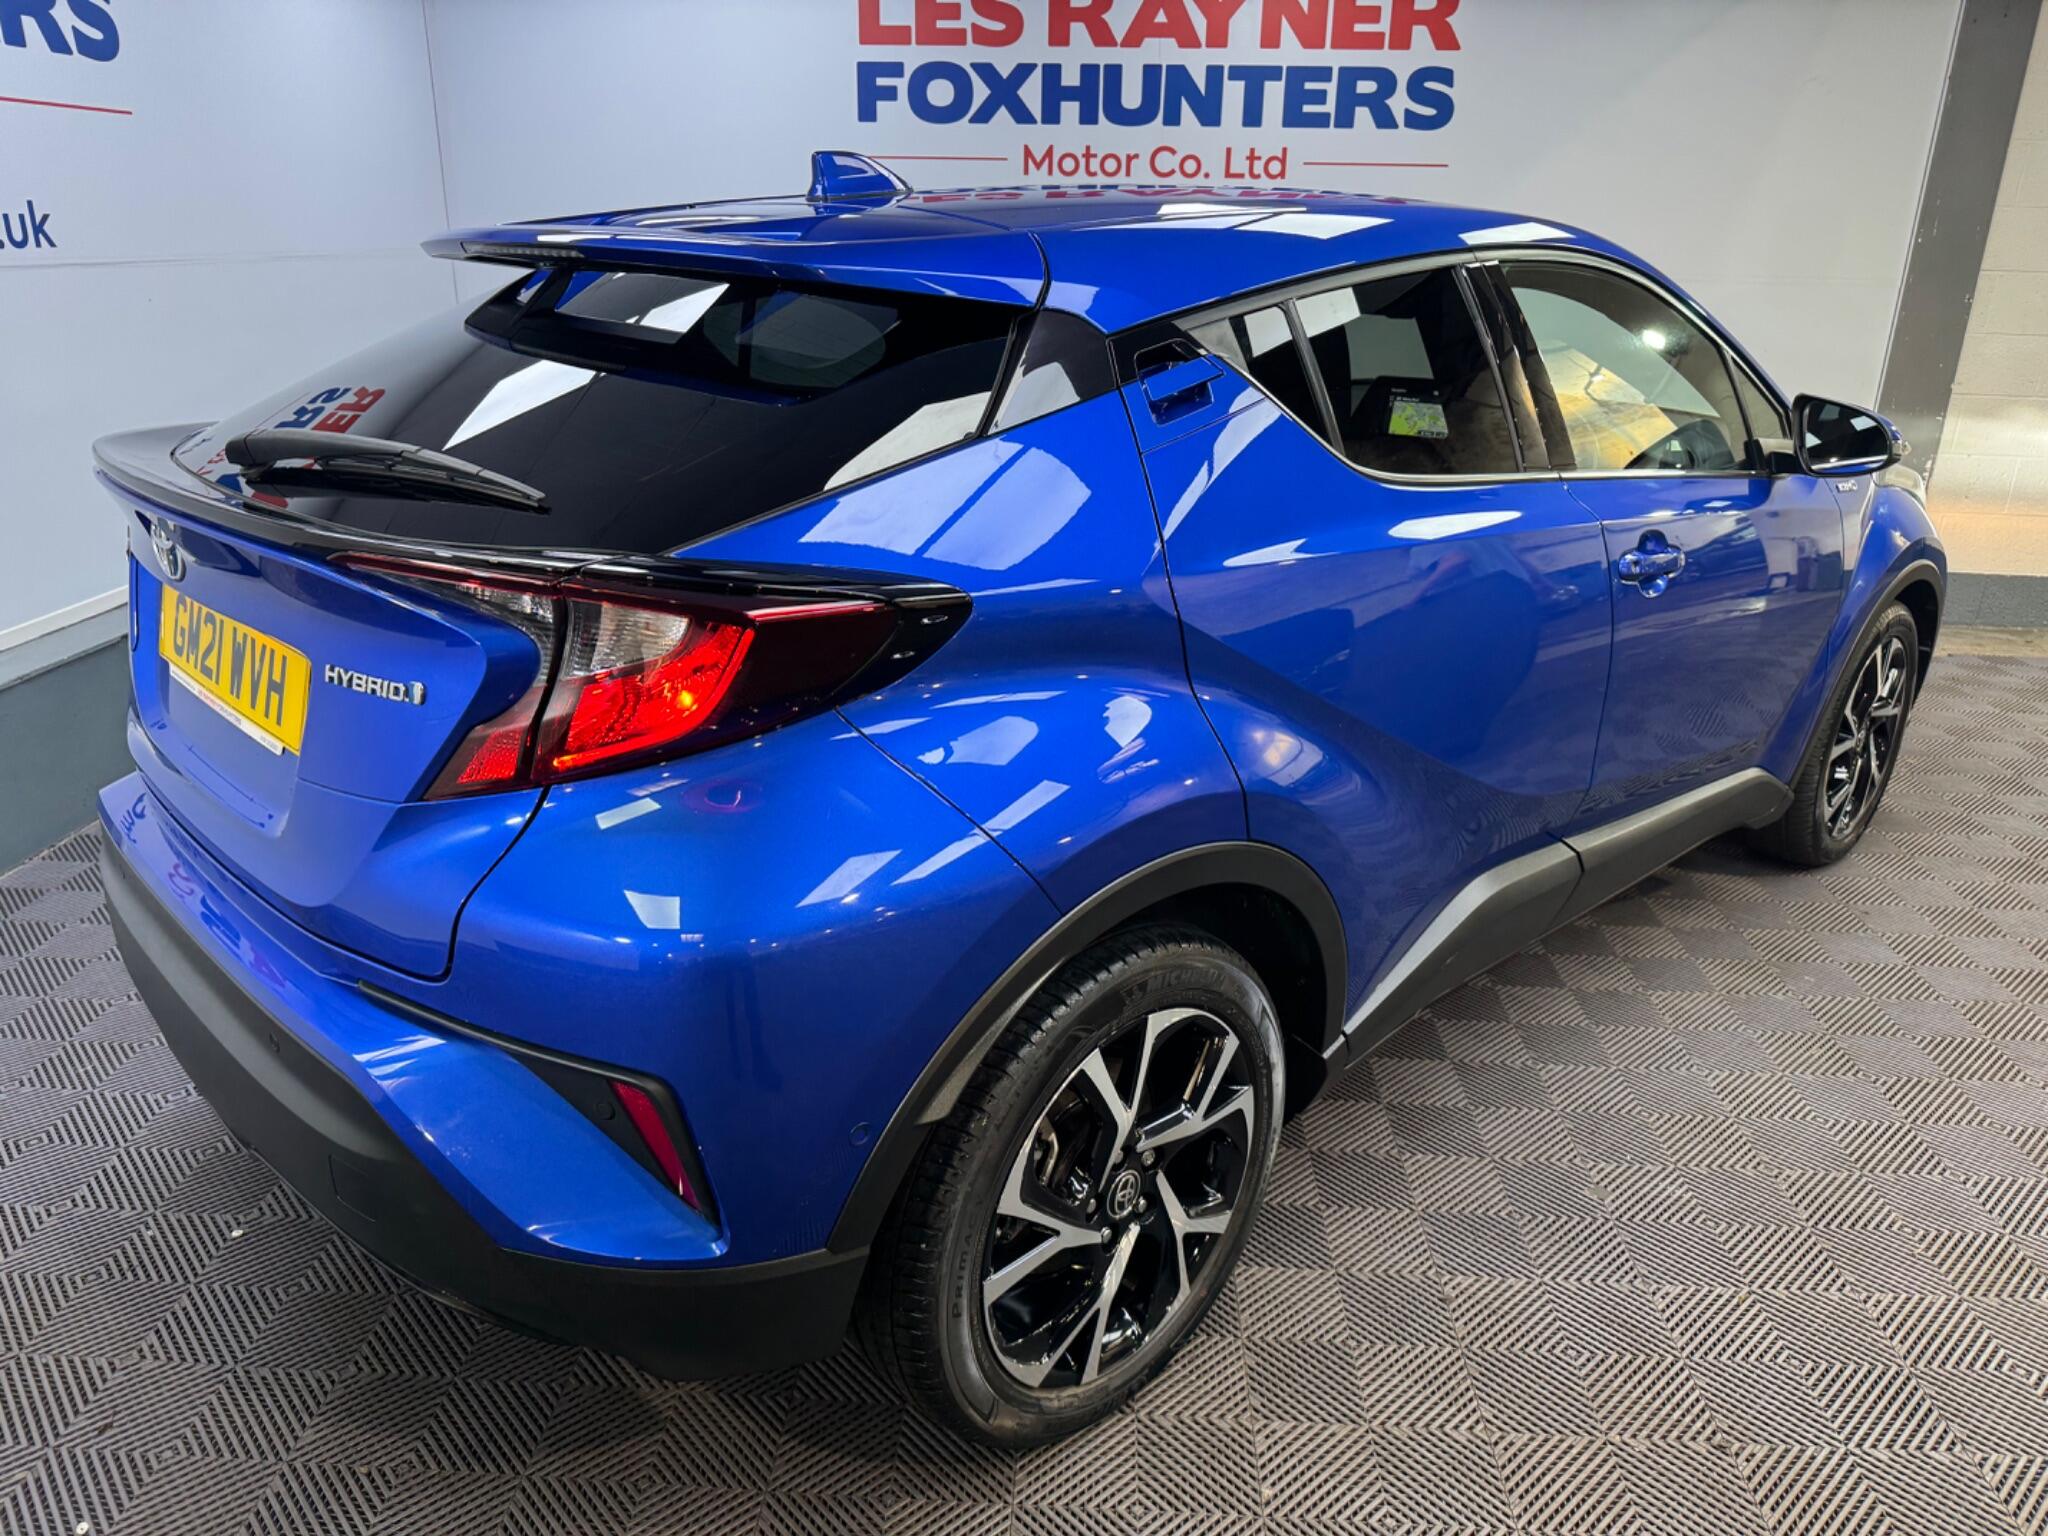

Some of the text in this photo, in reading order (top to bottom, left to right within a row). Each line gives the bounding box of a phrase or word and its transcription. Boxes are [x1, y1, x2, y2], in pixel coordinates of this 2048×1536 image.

[858, 0, 1461, 50] LES RAYNER
[856, 60, 1455, 131] FOXHUNTERS
[1022, 144, 1288, 180] Motor Co. Ltd
[173, 593, 288, 728] GM21 WVH
